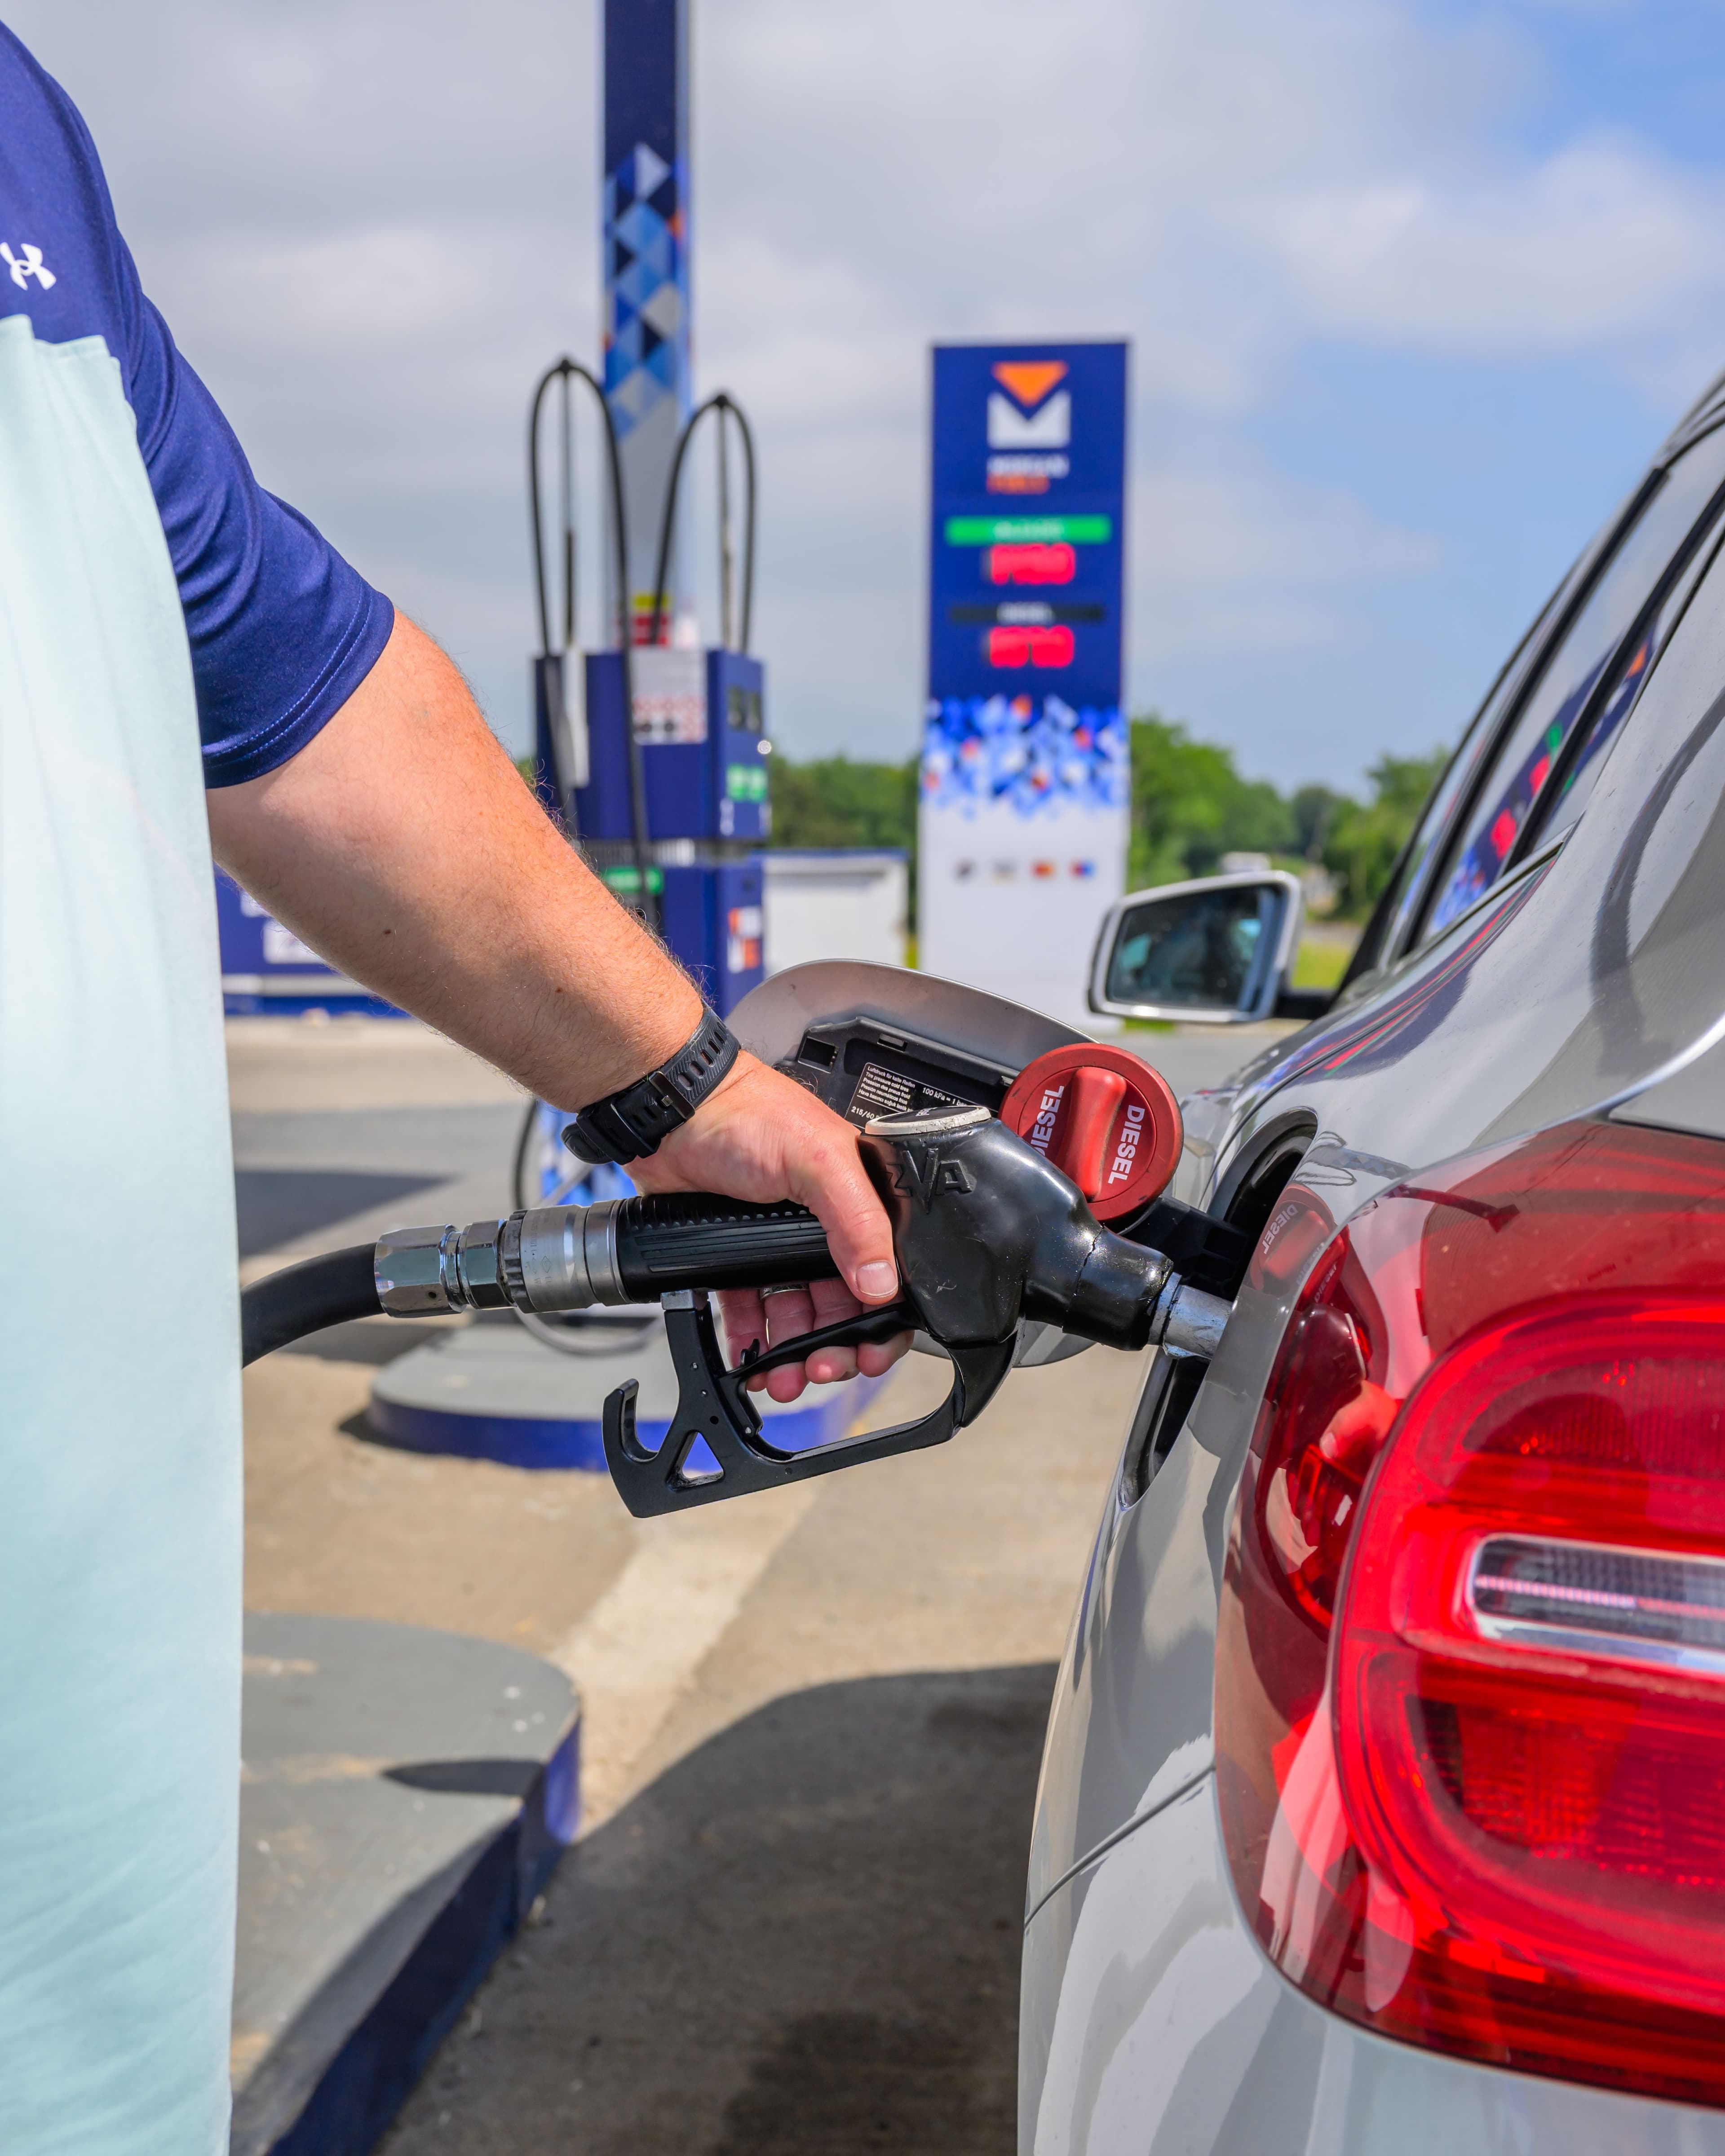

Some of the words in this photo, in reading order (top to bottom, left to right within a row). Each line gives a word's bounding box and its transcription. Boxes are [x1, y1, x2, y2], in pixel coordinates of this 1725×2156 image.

[922, 1087, 934, 1096] 100
[933, 1091, 946, 1100] kPa
[851, 1106, 875, 1120] 215/60
[1108, 1105, 1145, 1184] DIESEL
